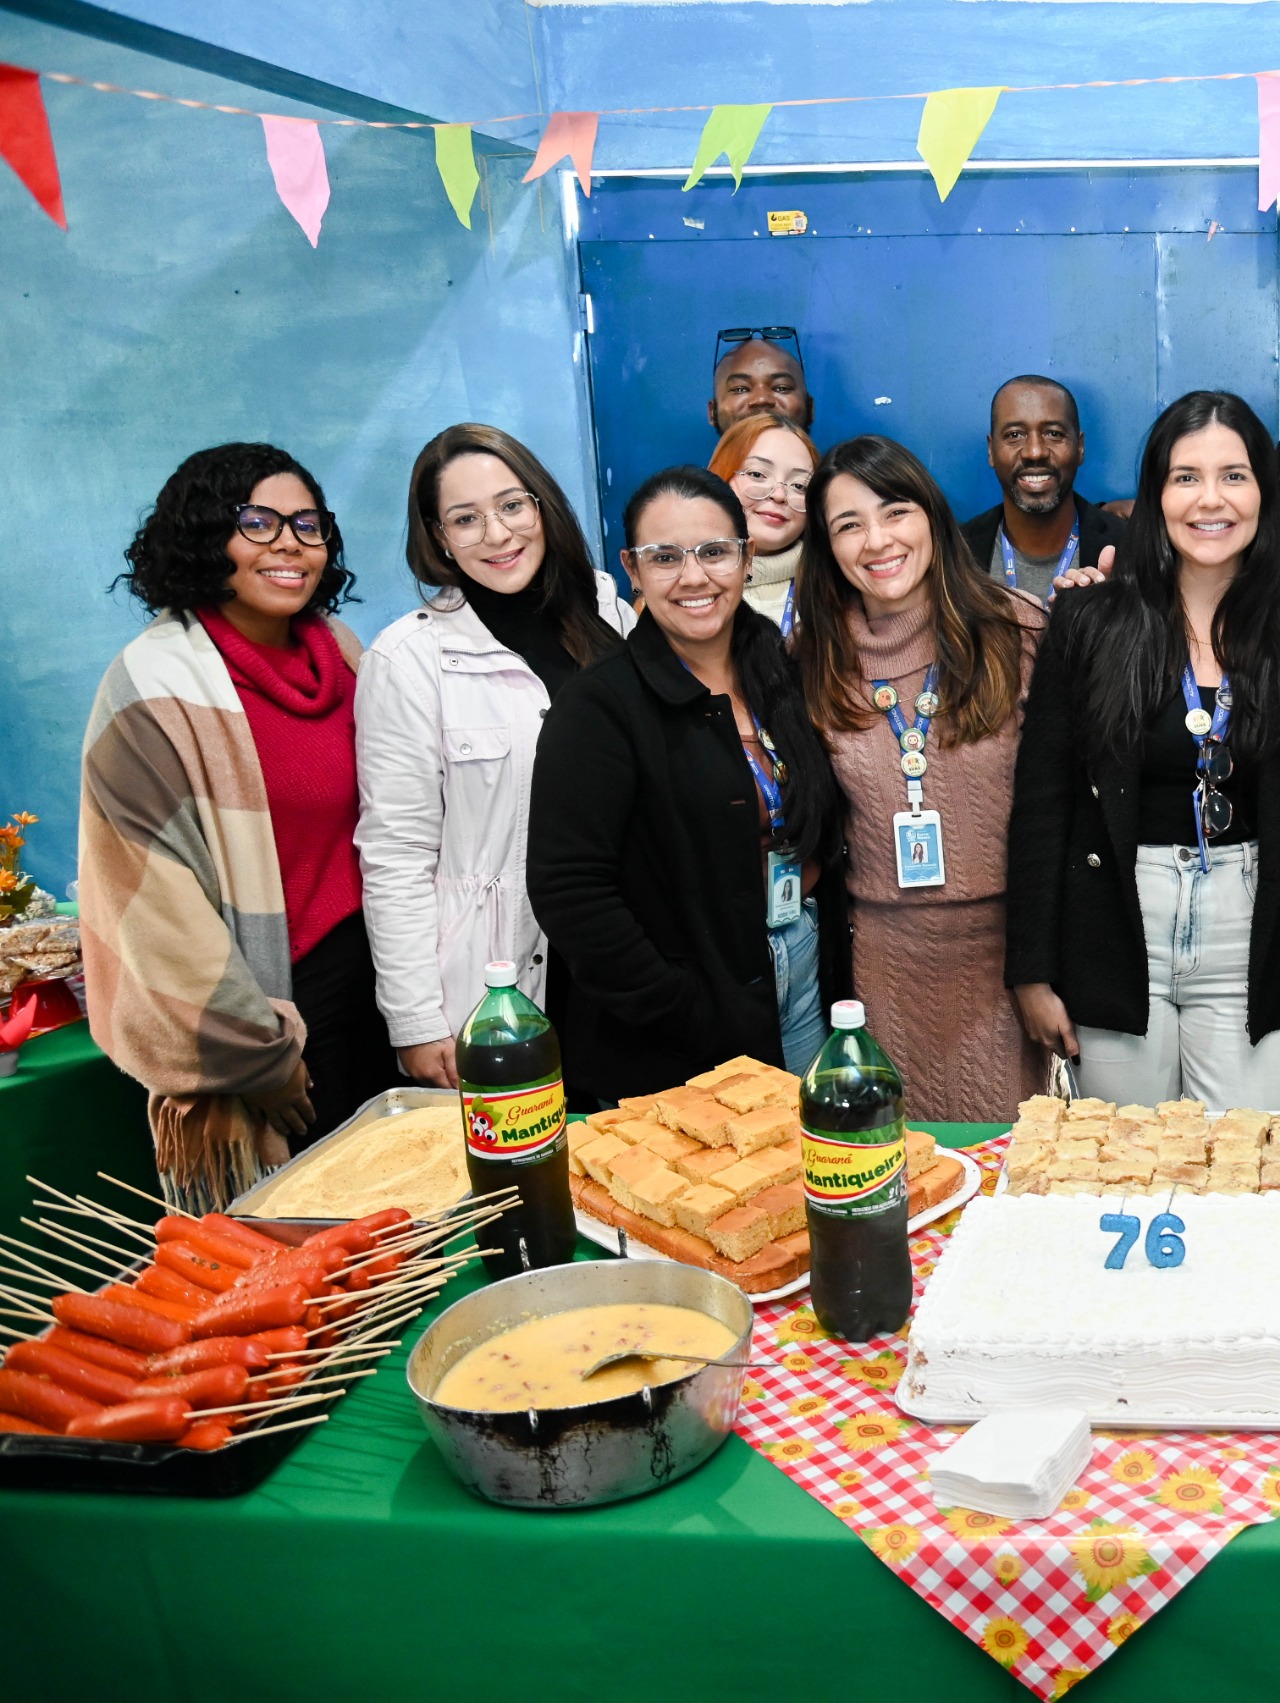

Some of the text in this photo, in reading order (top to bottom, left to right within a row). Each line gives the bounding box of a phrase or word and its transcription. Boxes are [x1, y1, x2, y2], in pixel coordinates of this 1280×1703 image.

[501, 1103, 565, 1143] Mantiqu
[505, 1093, 554, 1126] Guaraná
[805, 1150, 902, 1188] Mantiqueira
[806, 1149, 853, 1167] Guaraná
[1100, 1213, 1185, 1269] 76
